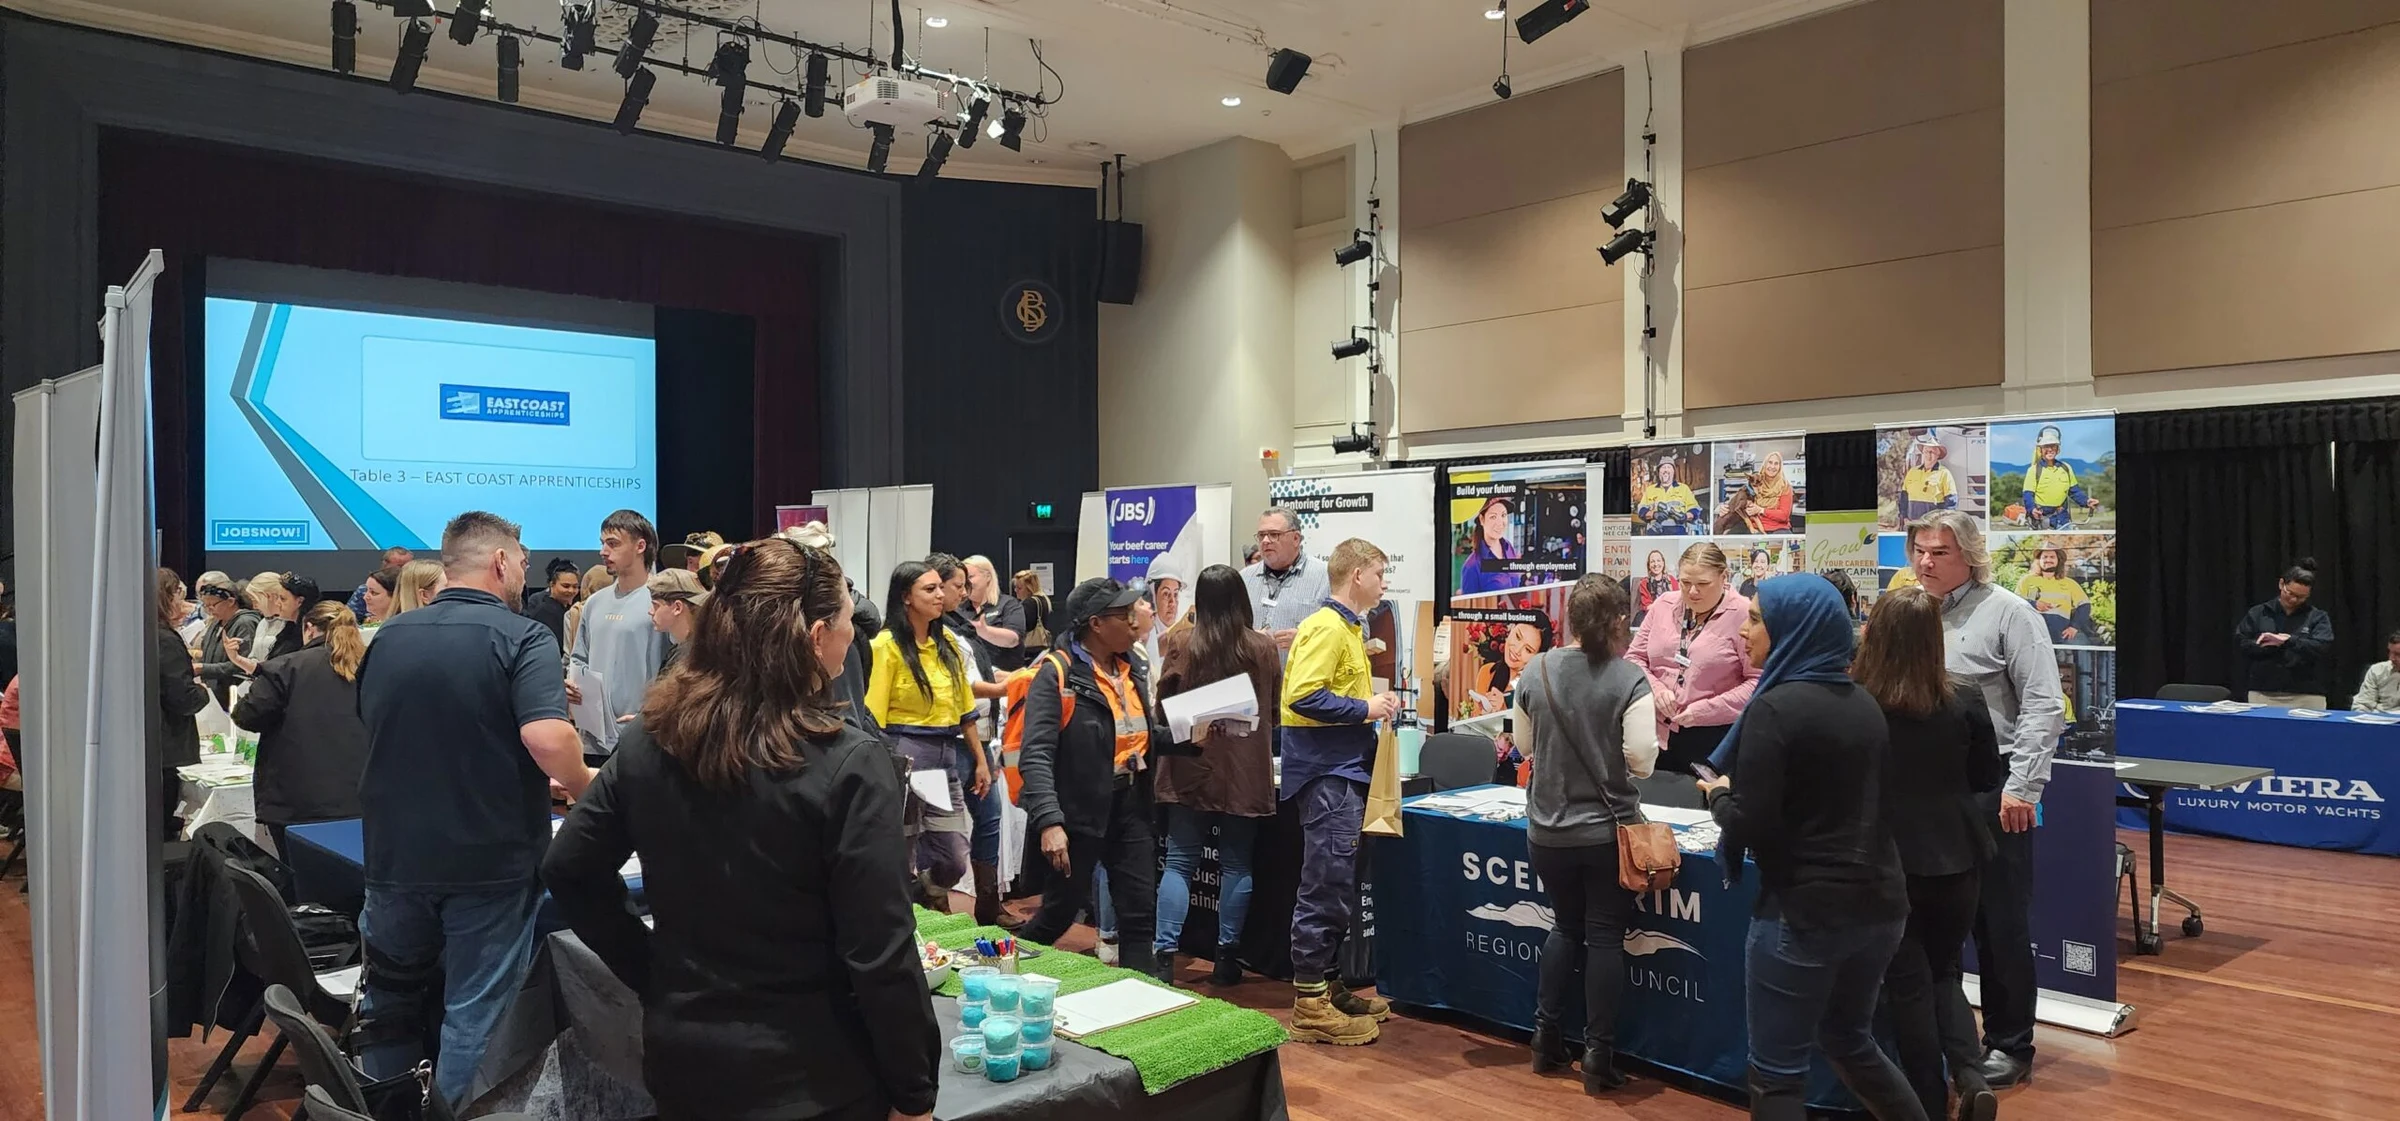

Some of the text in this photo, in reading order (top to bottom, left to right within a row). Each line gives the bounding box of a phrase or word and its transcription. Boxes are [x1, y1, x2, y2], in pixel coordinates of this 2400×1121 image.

[486, 408, 565, 419] APPRENTICESHIPS
[350, 469, 392, 482] Table
[397, 470, 406, 483] 3
[425, 471, 462, 484] EAST
[466, 473, 515, 486] COAST
[519, 474, 641, 490] APPRENTICESHIPS
[1456, 484, 1517, 497] Build your future
[1277, 495, 1369, 511] Mentoring for Growth
[221, 527, 301, 538] JOBSNOW!
[1109, 539, 1169, 551] Your beef career
[1109, 554, 1149, 565] starts here
[1390, 553, 1404, 562] that
[1811, 538, 1864, 569] Grow
[1509, 562, 1535, 572] through
[1535, 562, 1577, 572] employment
[1824, 559, 1875, 567] YOUR CAREER
[1458, 611, 1482, 621] through
[1490, 612, 1507, 620] small
[1507, 613, 1536, 622] business
[2178, 796, 2381, 820] LUXURY MOTOR YACHTS
[1362, 924, 1375, 938] and
[1630, 966, 1705, 1003] UNCIL
